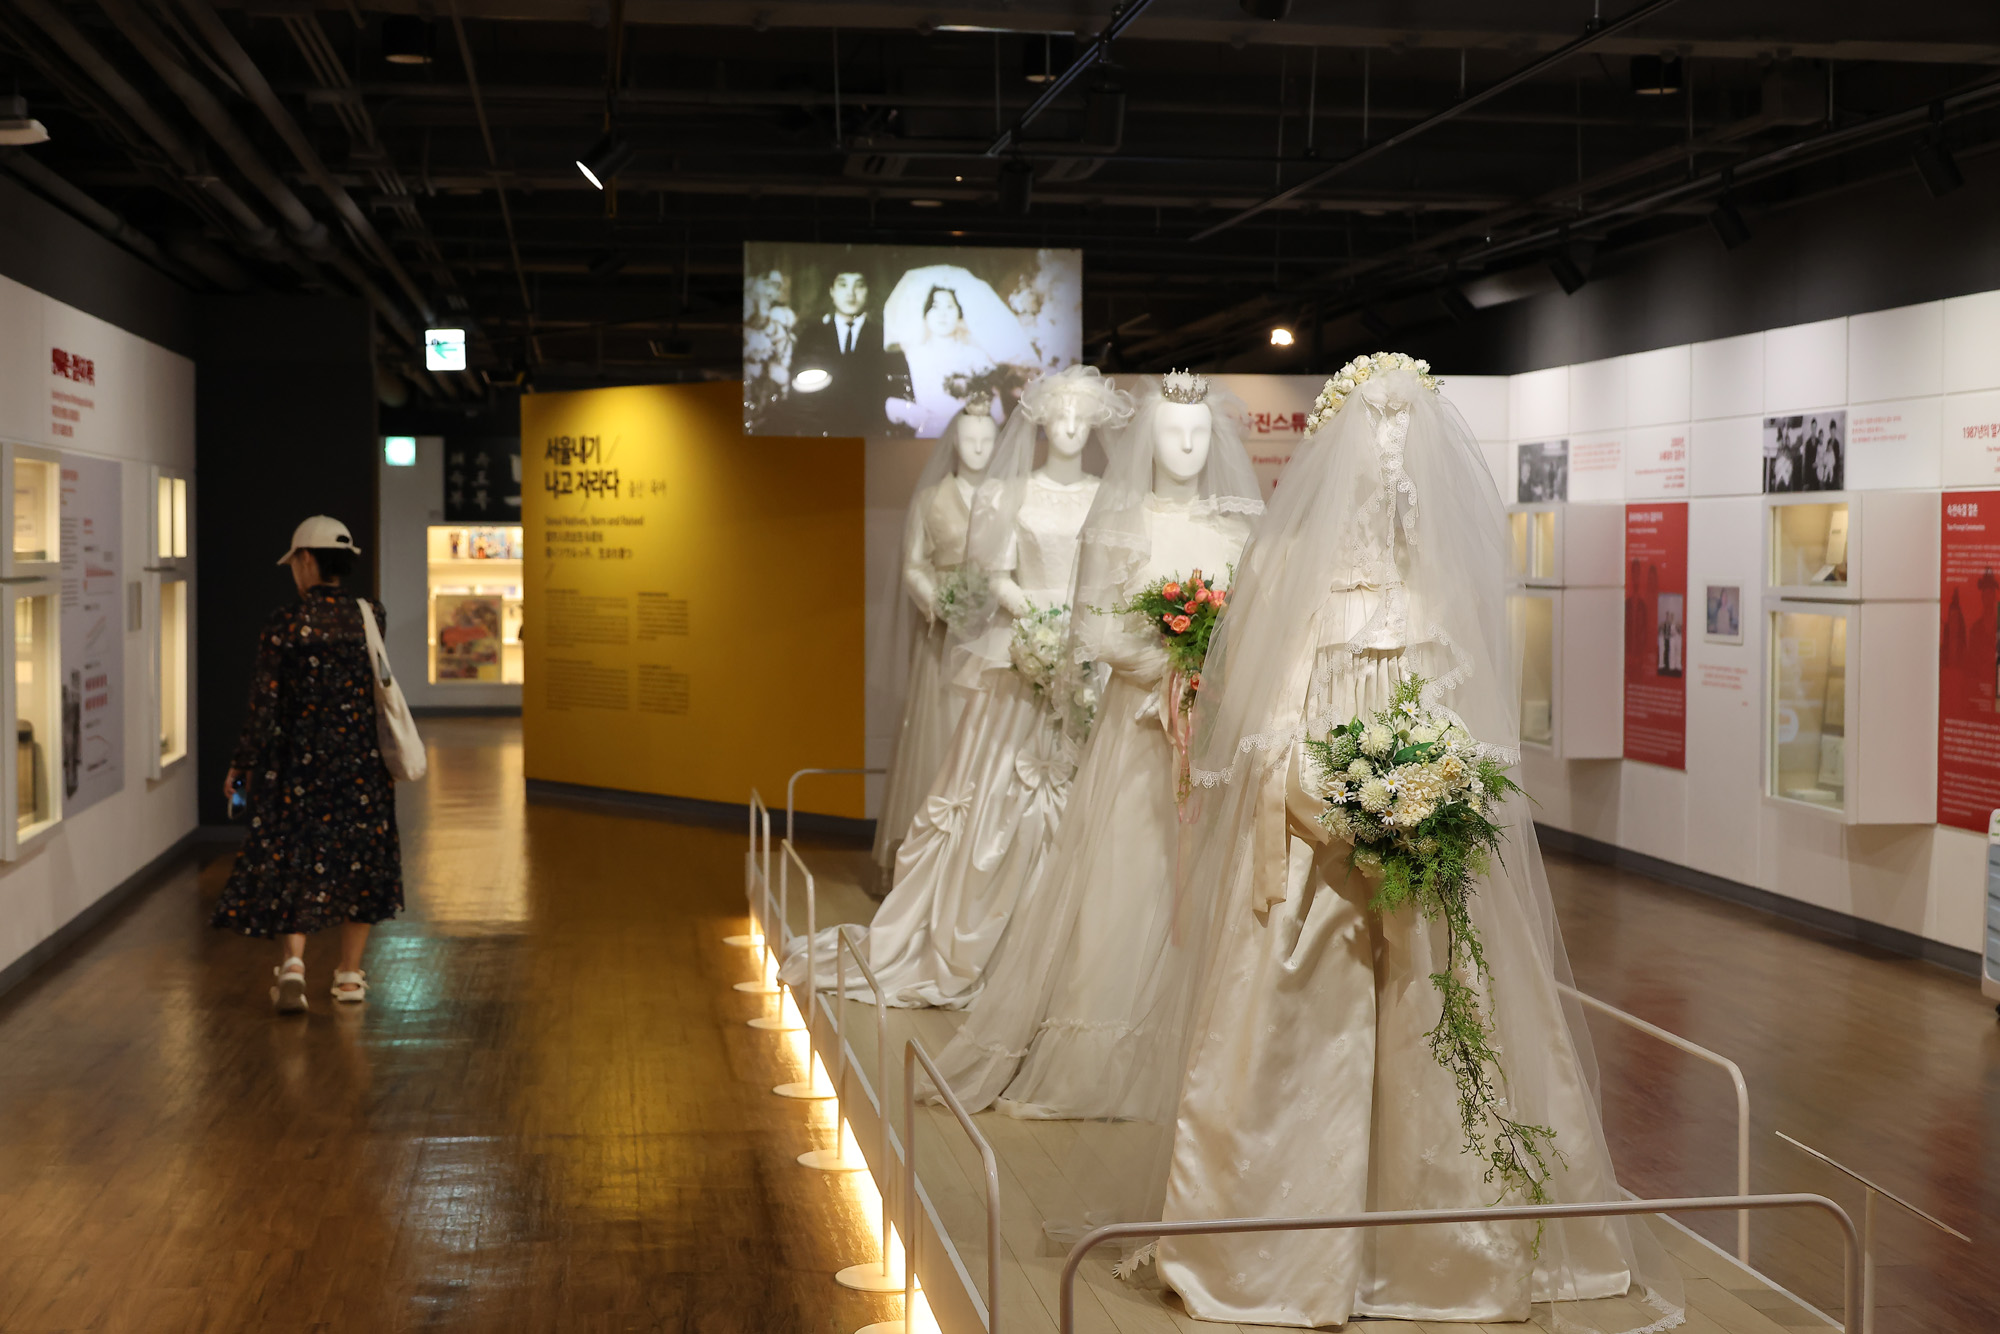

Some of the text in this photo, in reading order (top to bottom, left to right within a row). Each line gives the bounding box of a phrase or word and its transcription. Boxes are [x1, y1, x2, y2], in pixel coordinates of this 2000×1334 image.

[545, 434, 601, 465] 서울내기
[1252, 456, 1282, 465] Family
[545, 470, 573, 499] 나고
[576, 468, 620, 499] 자라다
